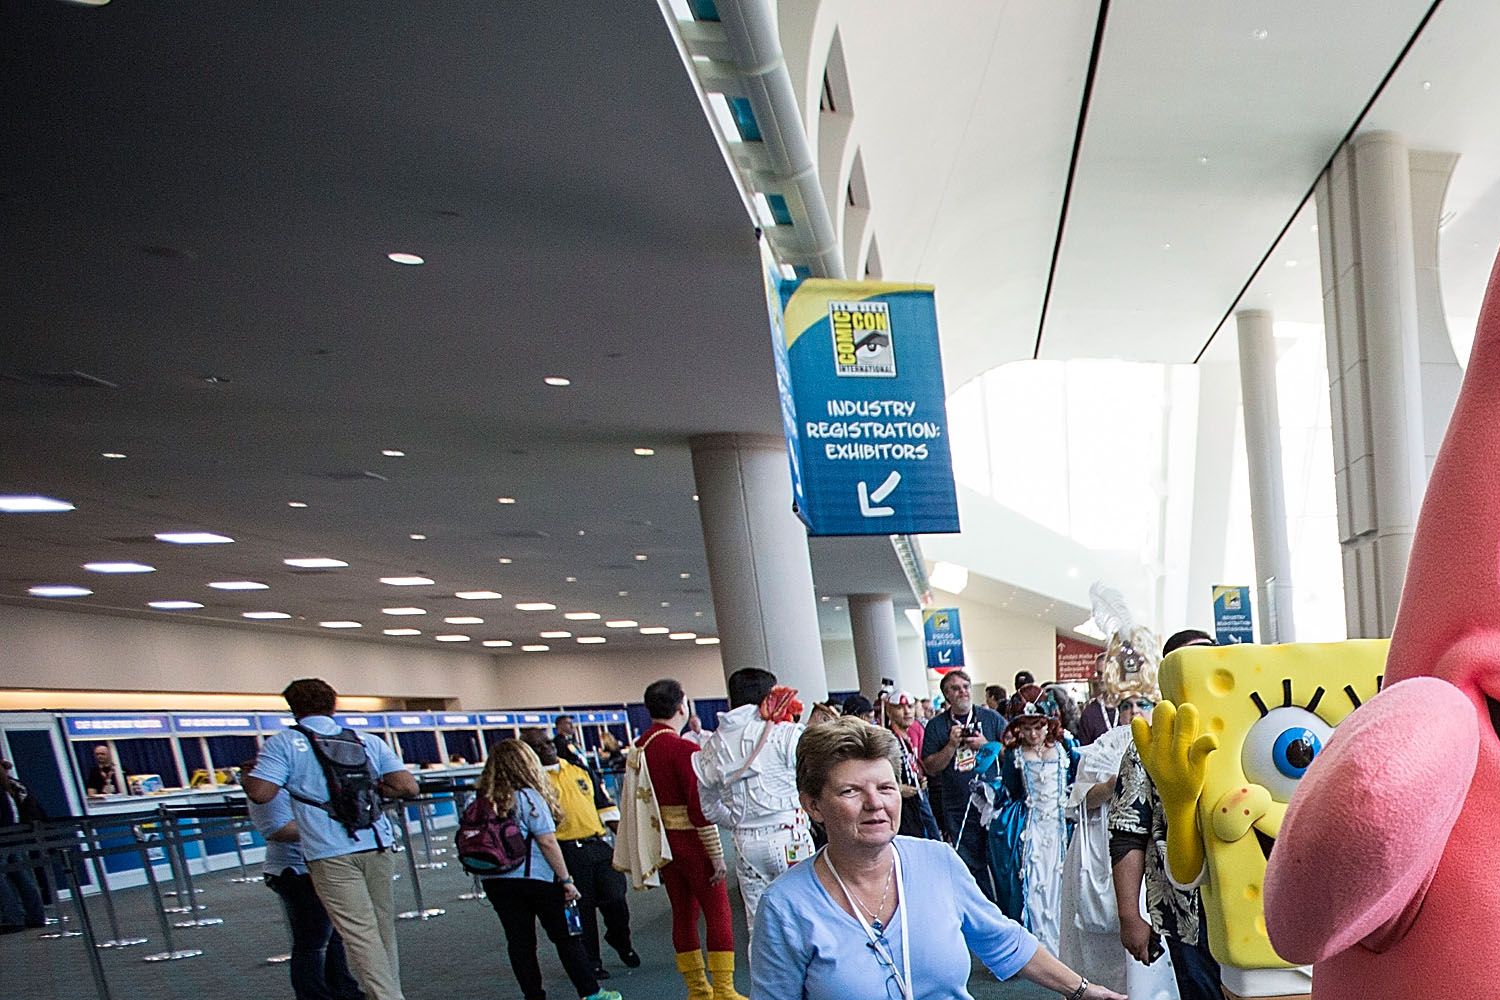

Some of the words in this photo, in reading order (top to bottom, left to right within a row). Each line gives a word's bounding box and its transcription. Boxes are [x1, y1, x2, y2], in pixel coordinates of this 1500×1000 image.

[852, 311, 888, 330] CON
[833, 311, 857, 365] COMIC
[839, 365, 893, 374] INTERNATIONAL
[827, 399, 916, 417] INDUSTRY
[806, 421, 941, 439] REGISTRATION:
[825, 442, 929, 460] EXHIBITORS
